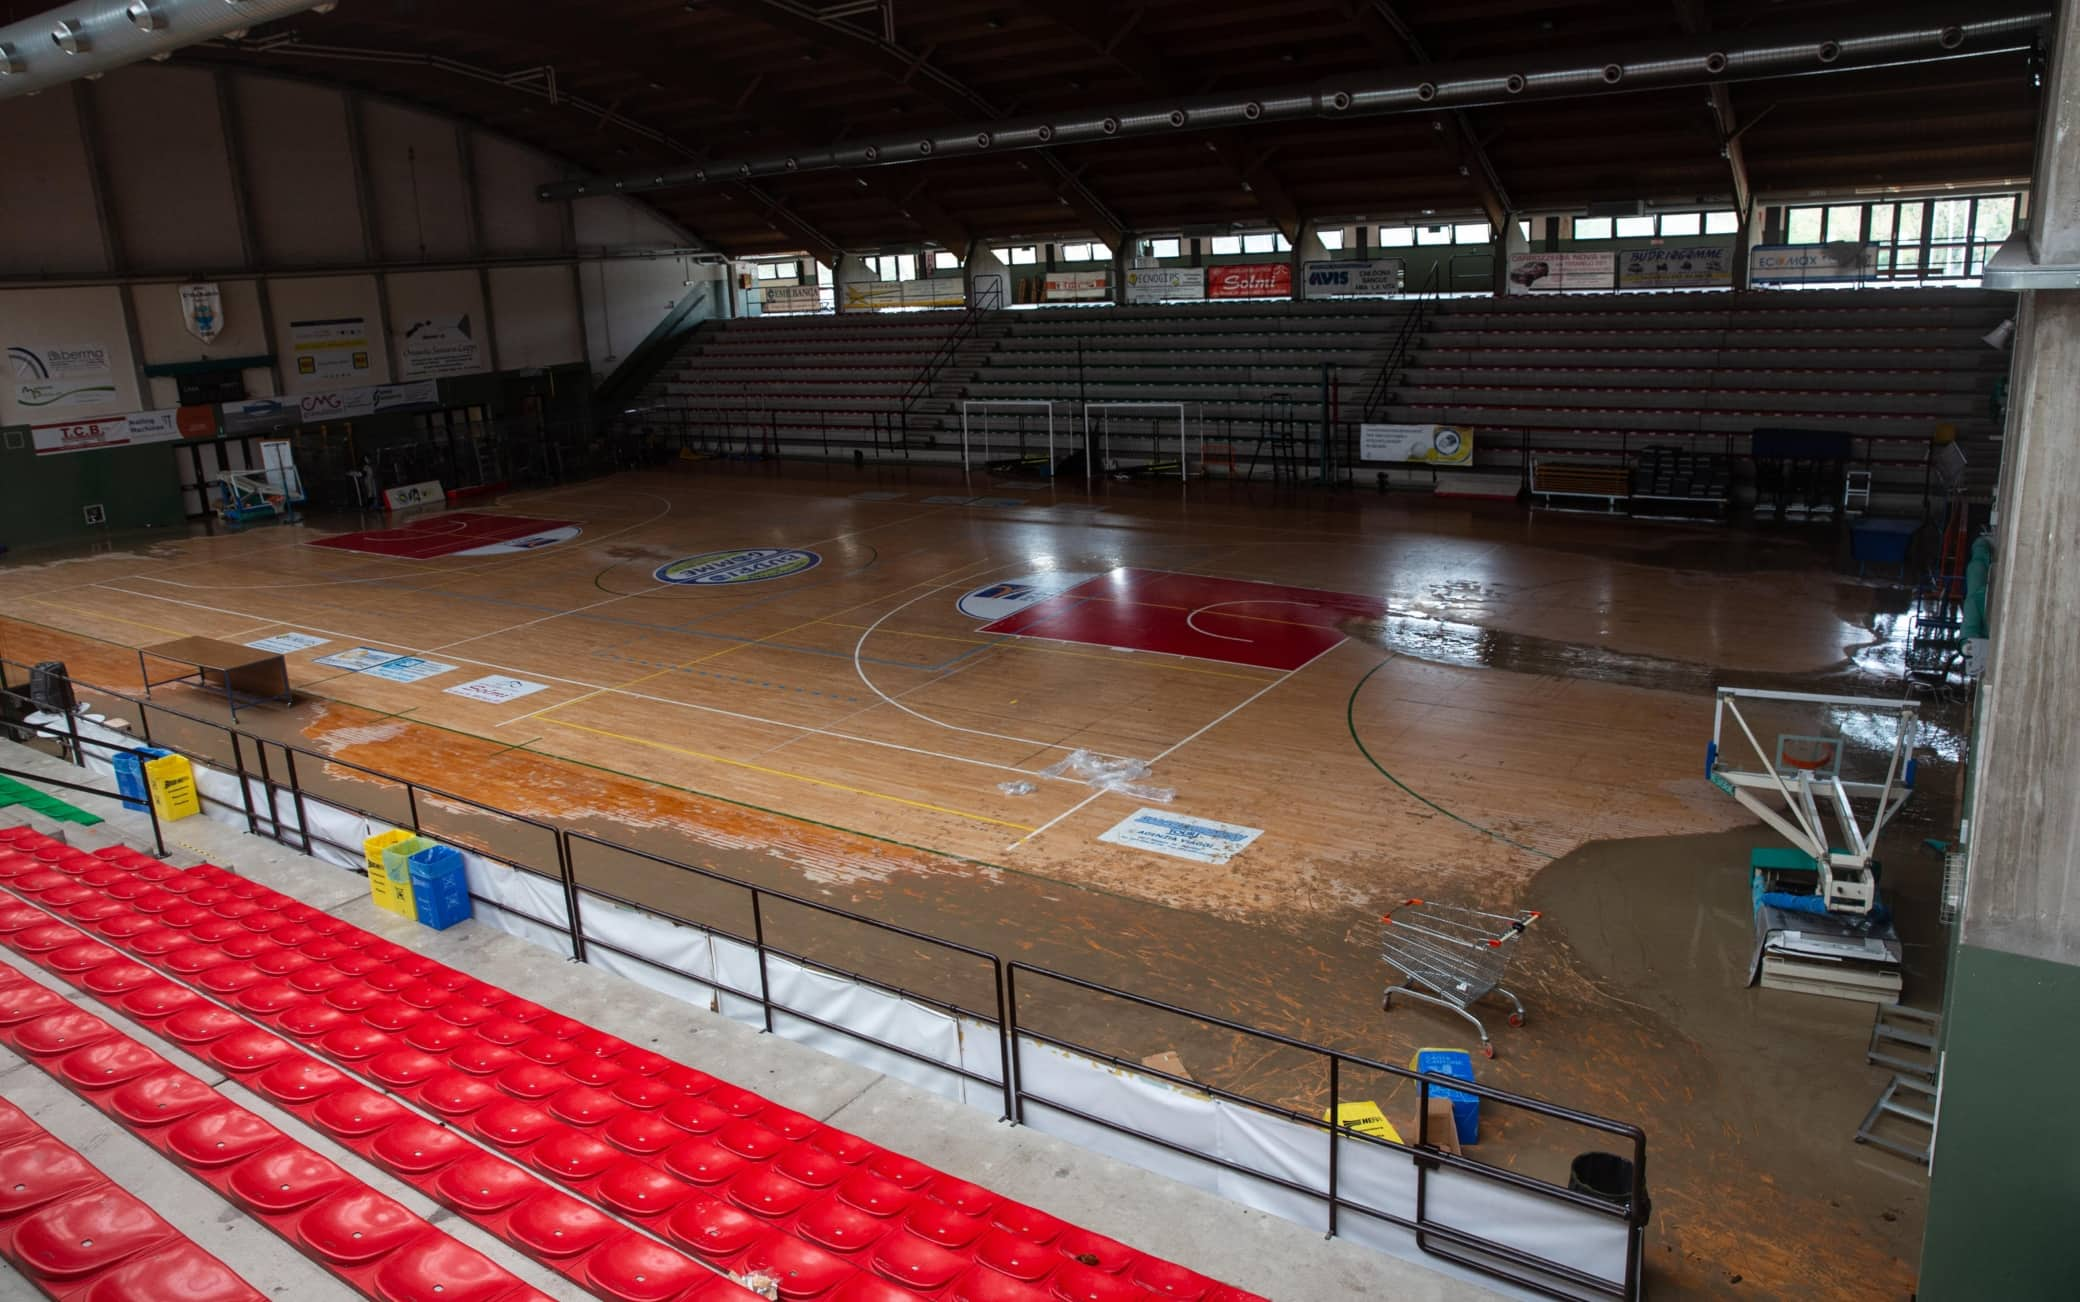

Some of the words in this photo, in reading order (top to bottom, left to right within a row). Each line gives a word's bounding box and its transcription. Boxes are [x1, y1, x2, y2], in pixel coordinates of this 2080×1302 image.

[1223, 274, 1276, 290] Solmi
[1309, 271, 1348, 285] AVIS
[301, 394, 341, 411] CMG
[680, 551, 763, 576] GOMME
[709, 554, 800, 581] BUDRIO
